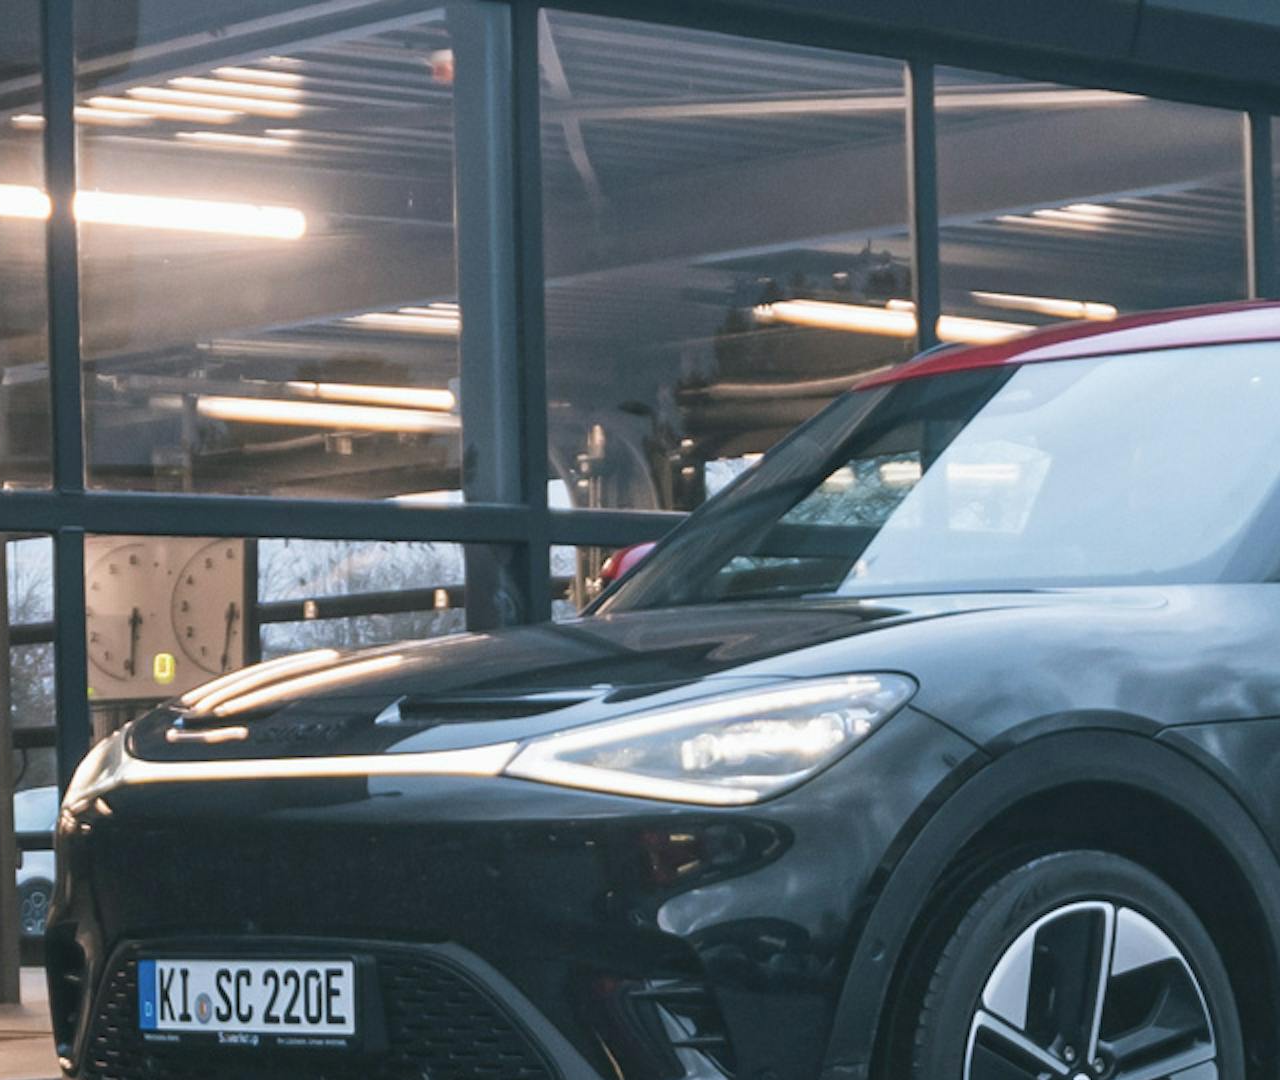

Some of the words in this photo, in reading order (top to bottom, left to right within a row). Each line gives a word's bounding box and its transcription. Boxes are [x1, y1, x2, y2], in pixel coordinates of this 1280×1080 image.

[158, 967, 192, 1022] KI
[215, 968, 253, 1023] SC
[262, 968, 347, 1024] 220E
